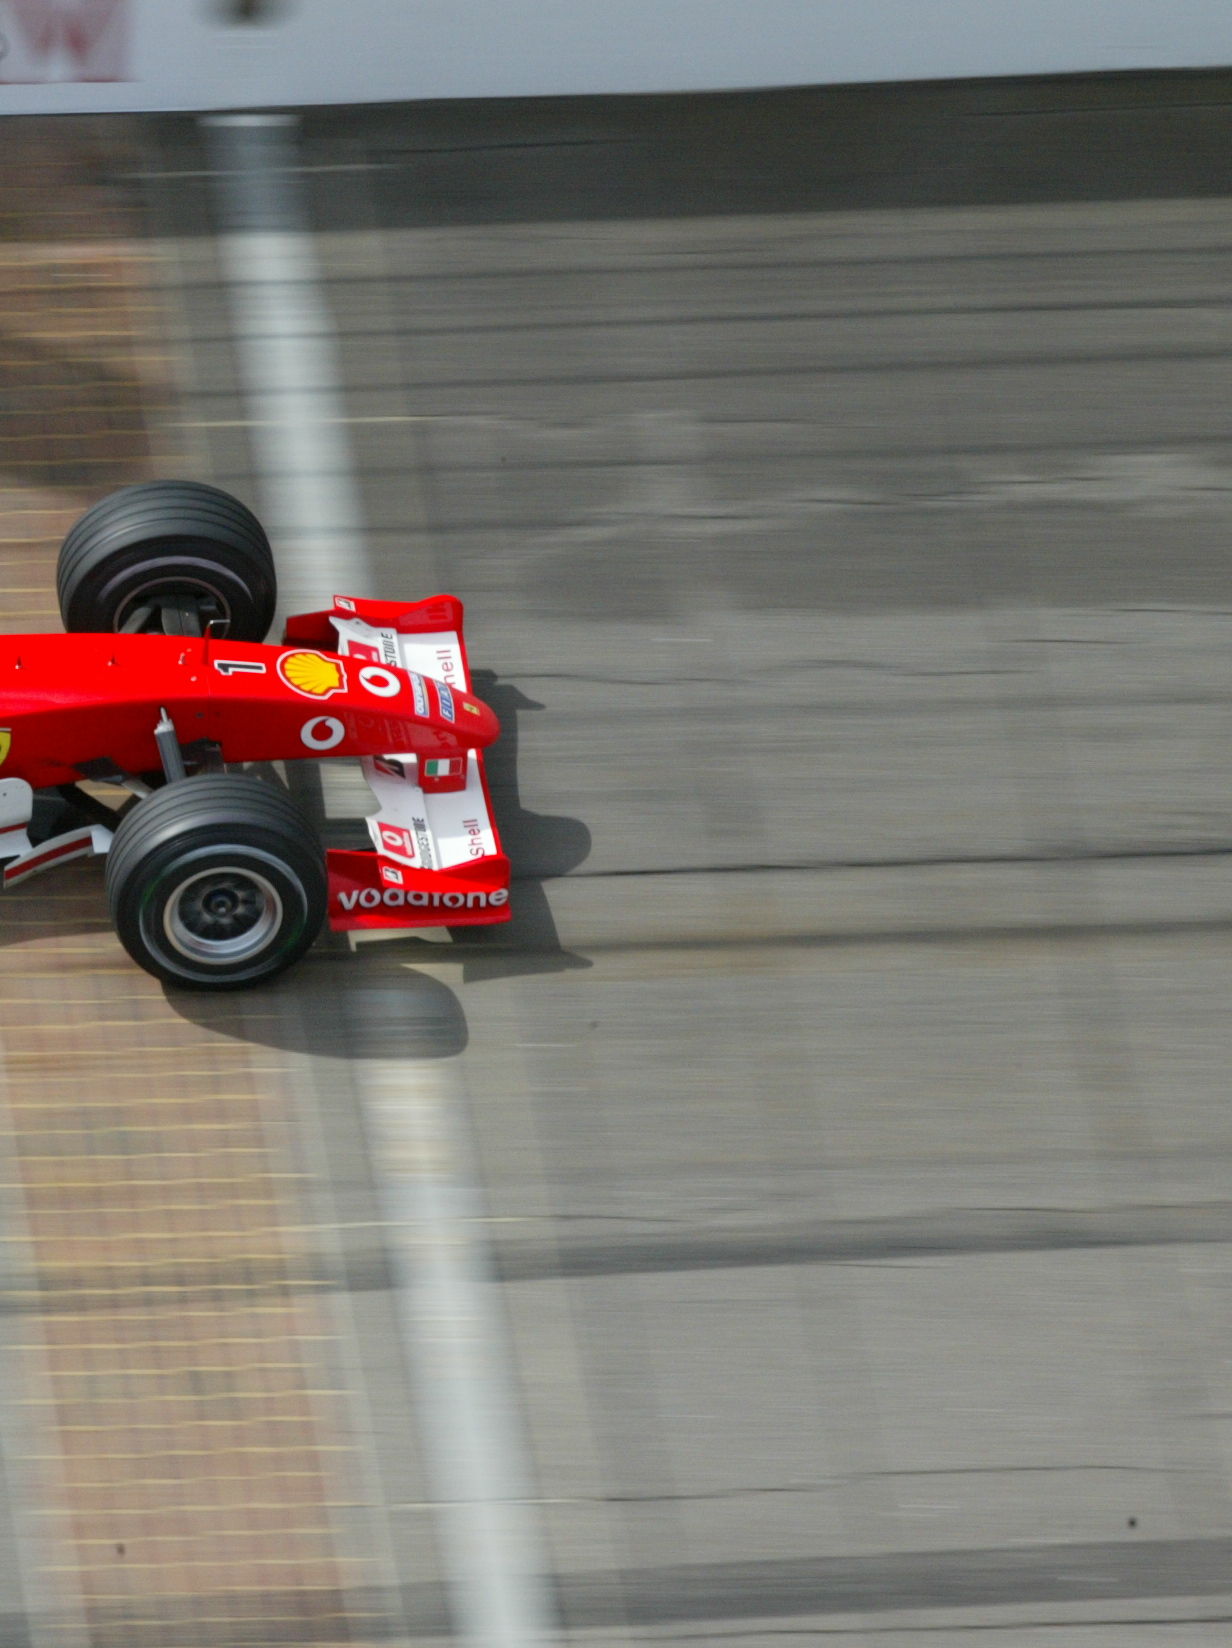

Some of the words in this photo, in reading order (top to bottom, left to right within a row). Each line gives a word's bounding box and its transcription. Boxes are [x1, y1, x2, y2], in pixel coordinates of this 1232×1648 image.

[215, 660, 265, 675] 1
[436, 649, 456, 686] hell
[462, 818, 486, 858] Shell
